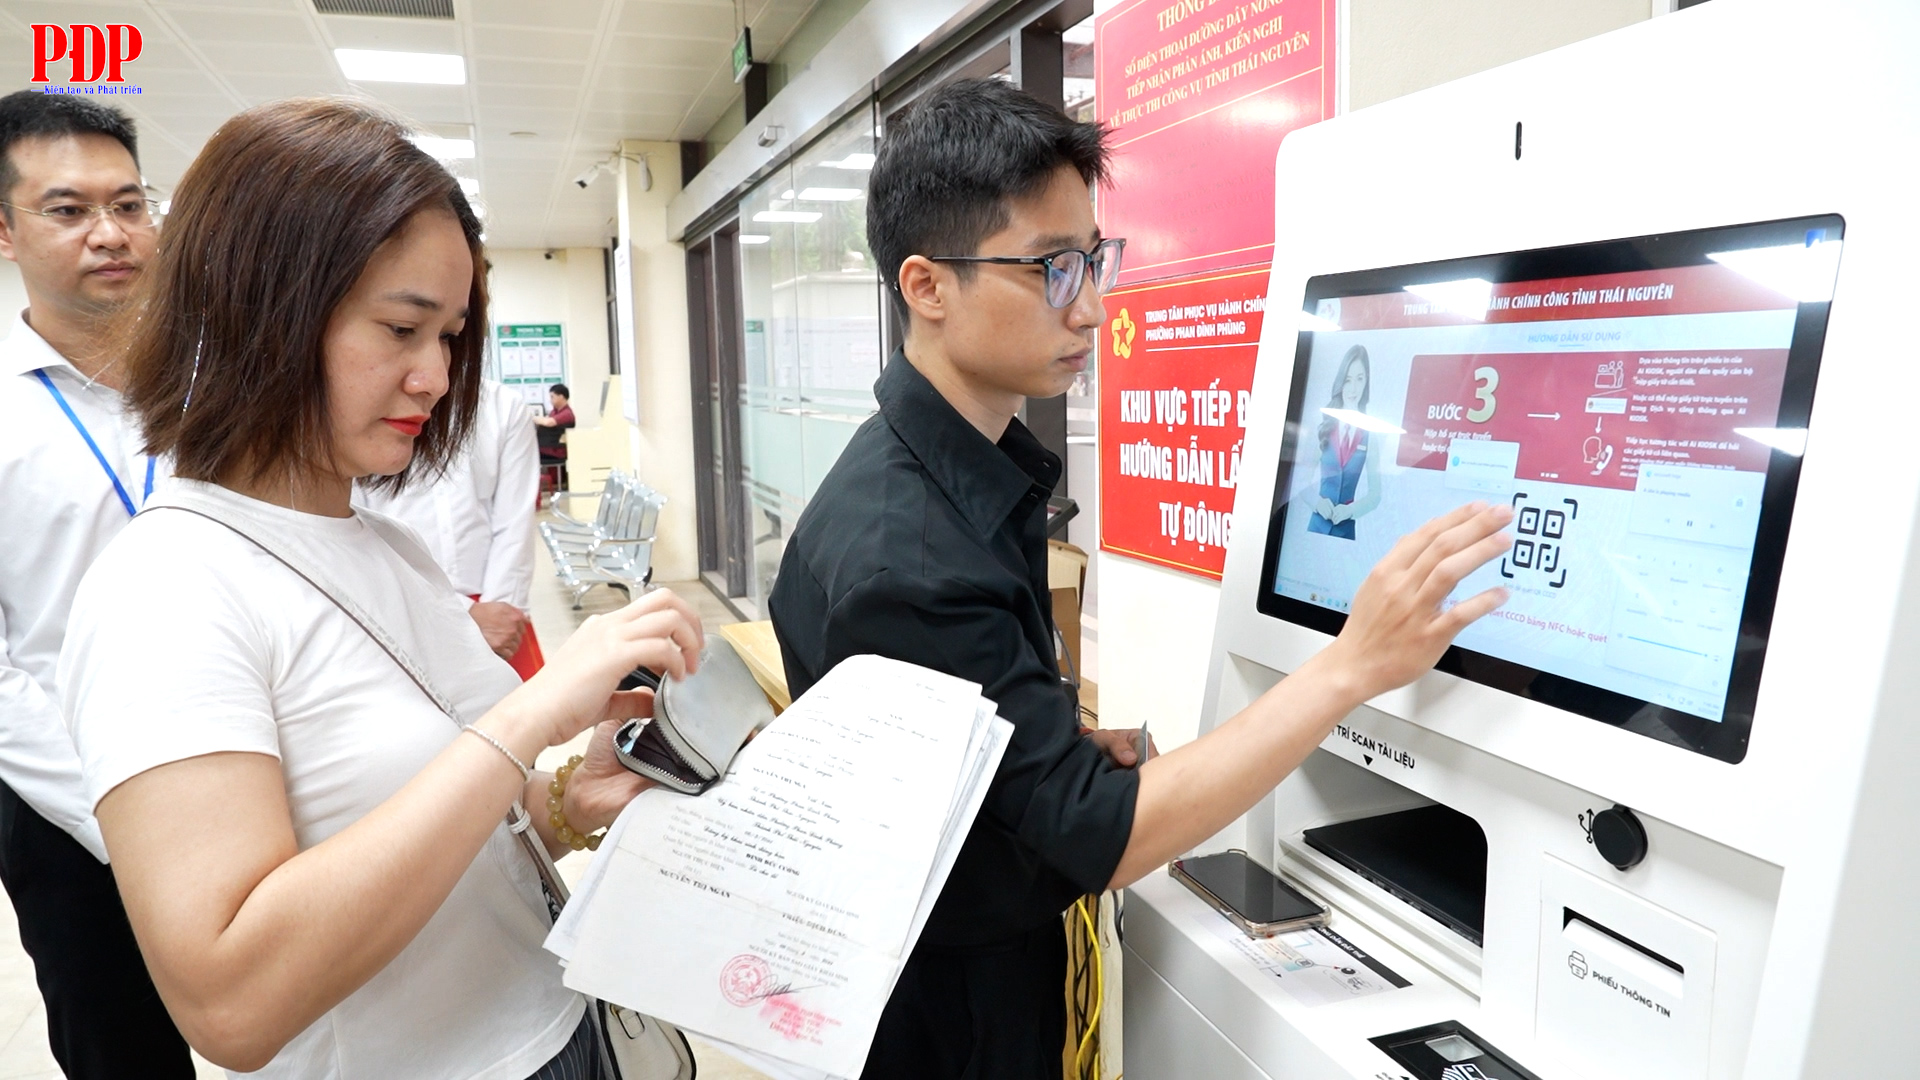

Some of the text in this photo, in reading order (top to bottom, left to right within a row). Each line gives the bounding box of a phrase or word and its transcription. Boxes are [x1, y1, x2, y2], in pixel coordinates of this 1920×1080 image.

[1125, 56, 1136, 78] SỐ
[1137, 51, 1158, 72] ĐIỆN
[1159, 36, 1188, 60] THOẠI
[1189, 18, 1224, 47] ĐƯỜNG
[1226, 5, 1248, 29] DÂY
[1126, 15, 1283, 100] TIẾP NHẬN PHẢN ÁNH, KIẾN NGHỊ
[1110, 31, 1311, 128] VỀ THỰC THI CÔNG VỤ TỈNH THÁI NGUYÊN
[1145, 310, 1168, 323] TRUNG
[1168, 305, 1183, 321] TÂM
[1184, 305, 1205, 322] PHỤC
[1206, 303, 1217, 320] VỤ
[1218, 299, 1242, 316] HÀNH
[1511, 293, 1541, 309] CHÍNH
[1542, 290, 1569, 307] CÔNG
[1571, 288, 1596, 305] TỈNH
[1599, 286, 1625, 303] THÁI
[1627, 283, 1674, 301] NGUYÊN
[1145, 319, 1246, 341] PHƯỜNG PHAN ĐÌNH PHÙNG
[1120, 390, 1151, 423] KHU
[1154, 386, 1187, 432] VỰC
[1191, 378, 1232, 428] TIẾP
[1427, 366, 1499, 423] BƯỚC 3
[1120, 437, 1173, 482] HƯỚNG
[1176, 434, 1214, 487] DẪN
[1159, 500, 1234, 552] TỰ ĐỘNG
[1505, 611, 1526, 623] CCCD
[1548, 621, 1566, 633] NFC
[1337, 725, 1415, 769] TRÍ SCAN TÀI LIỆU
[1592, 970, 1671, 1018] PHIẾU THÔNG TIN
